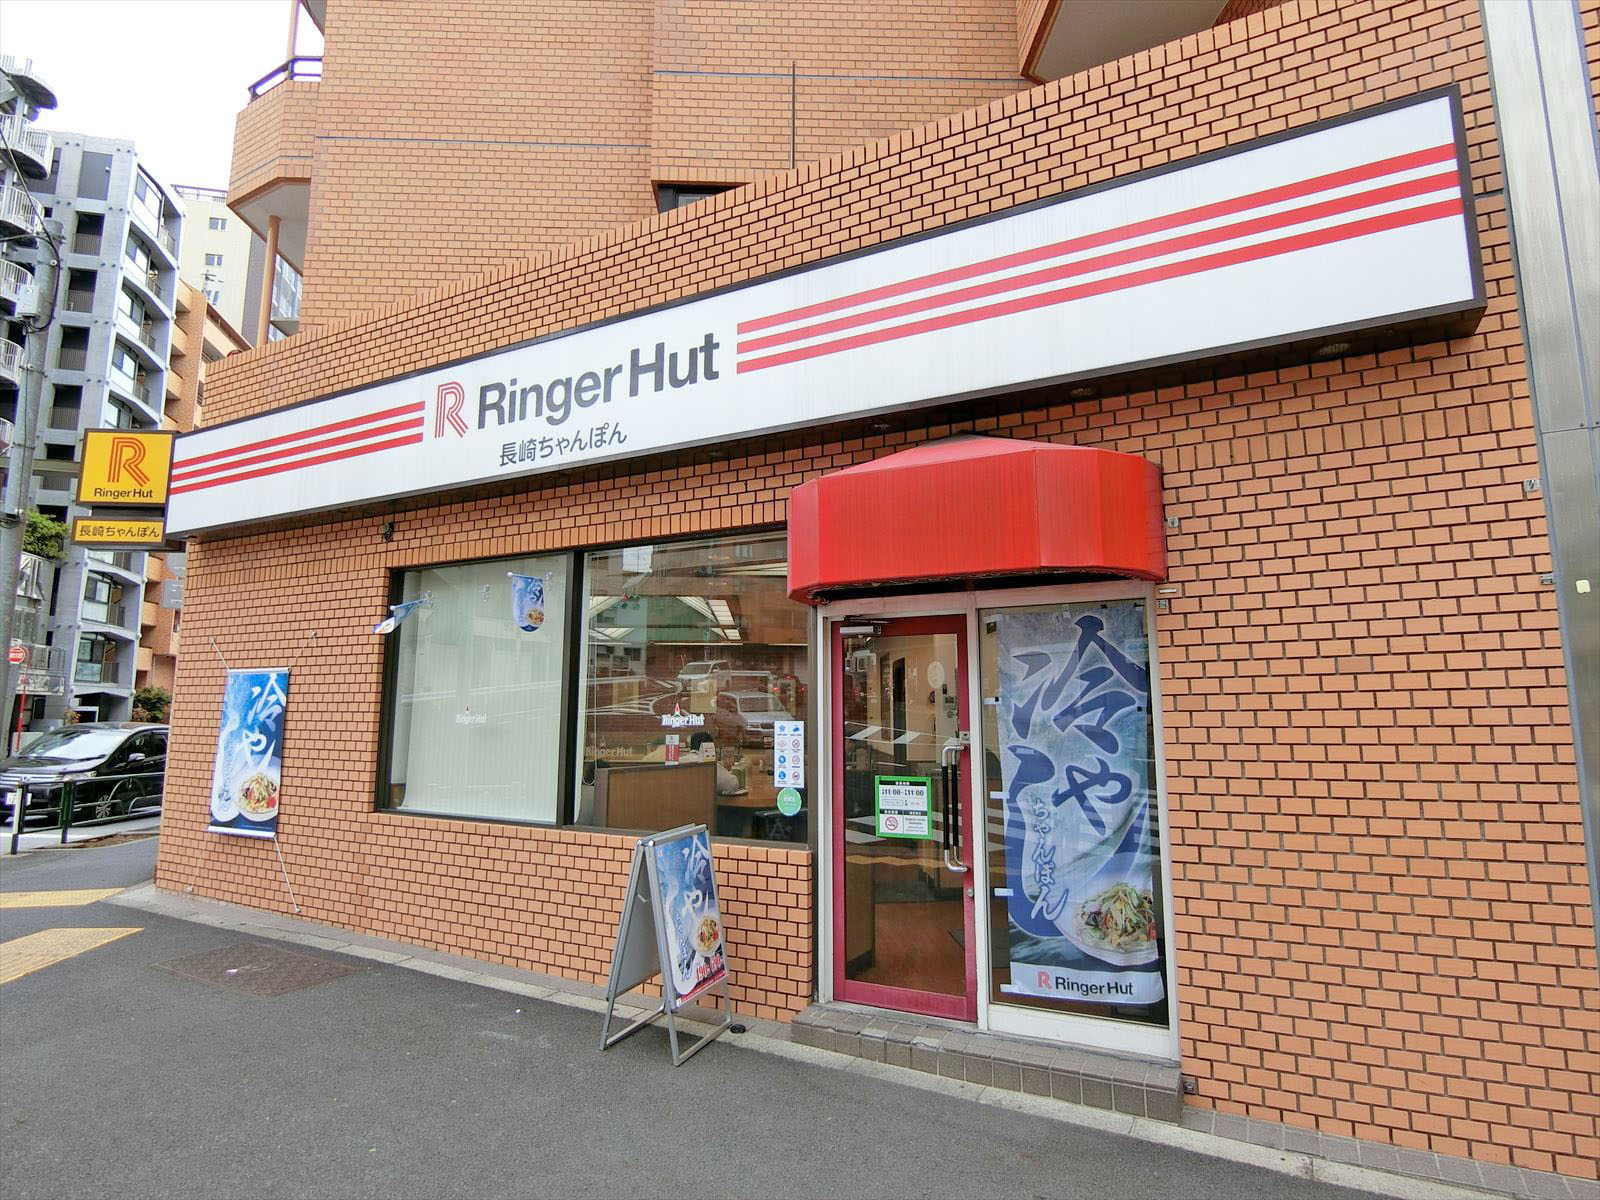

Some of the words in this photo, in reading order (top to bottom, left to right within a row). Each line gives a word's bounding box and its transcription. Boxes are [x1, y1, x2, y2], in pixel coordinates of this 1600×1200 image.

[499, 422, 627, 467] 長崎ちゃんぽん
[79, 525, 160, 537] 長崎ちゃんぽん
[1031, 797, 1069, 921] ちゃんぽん
